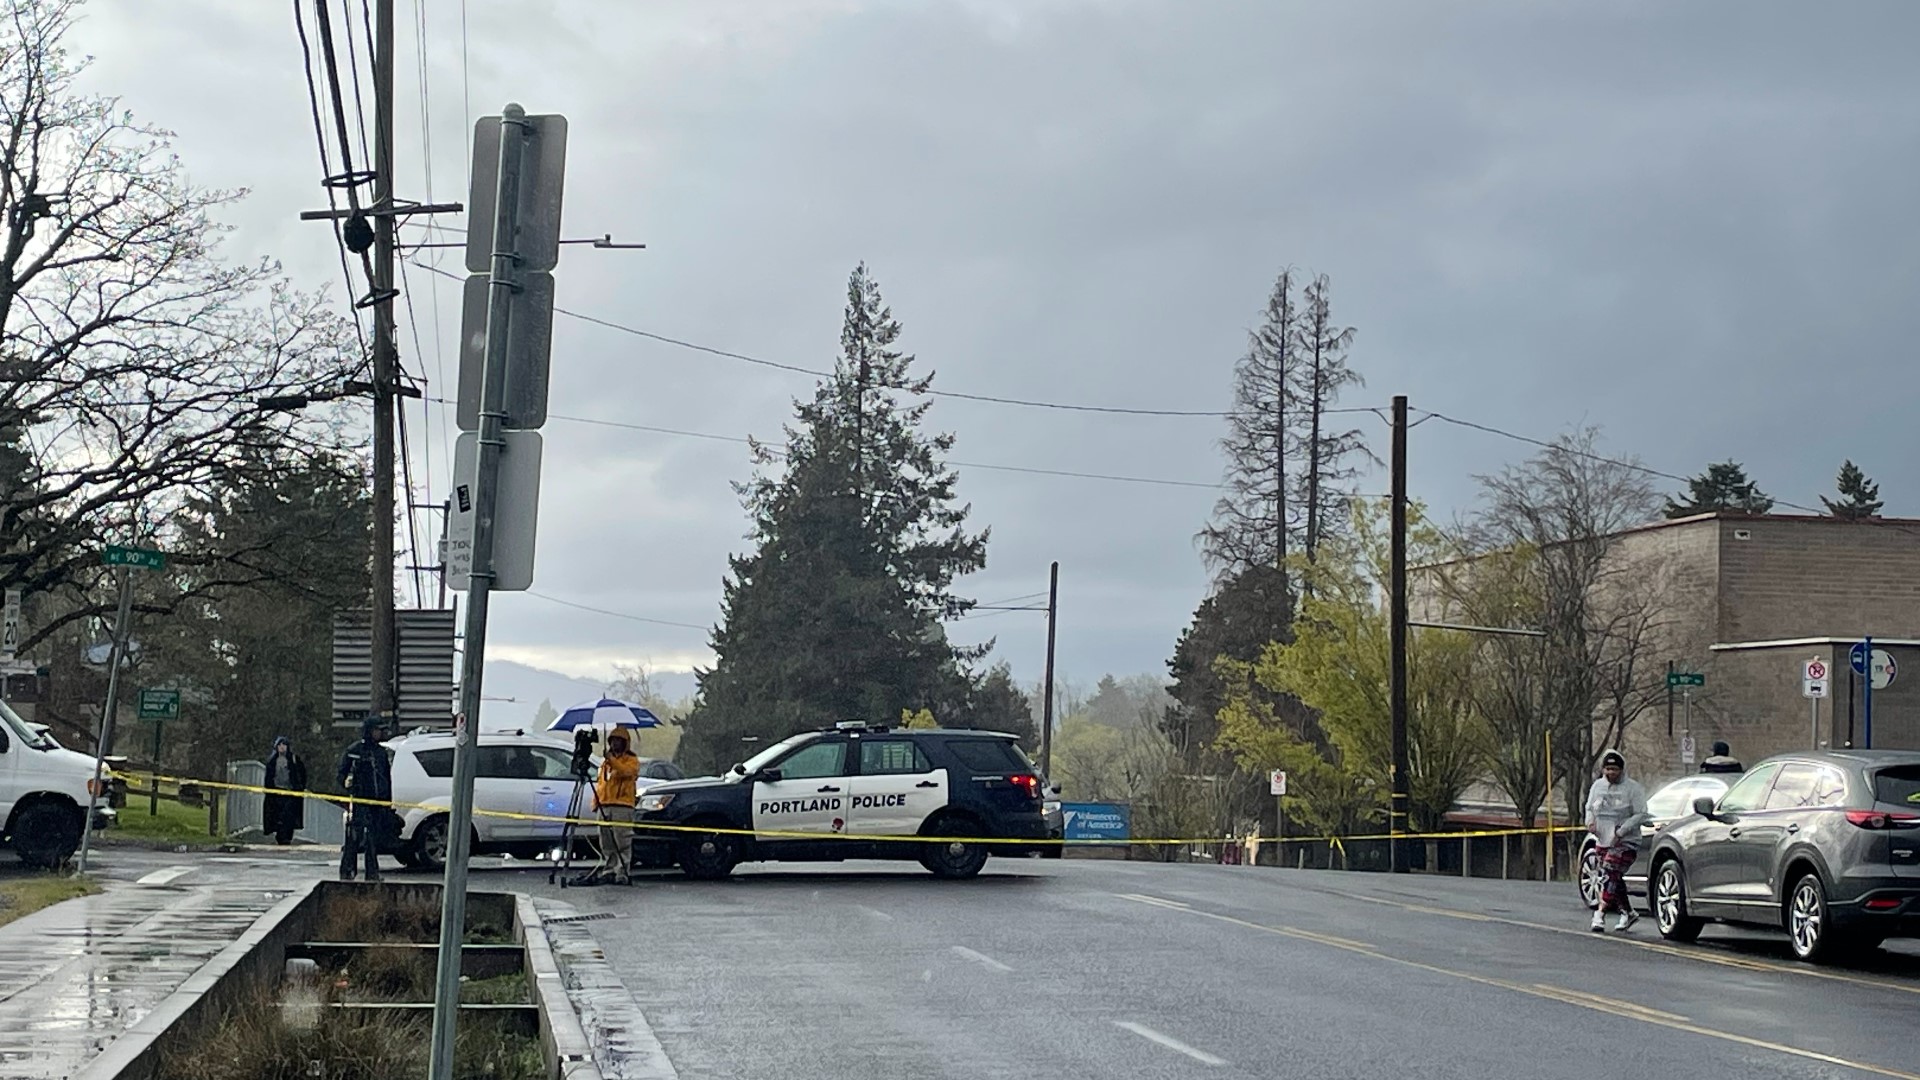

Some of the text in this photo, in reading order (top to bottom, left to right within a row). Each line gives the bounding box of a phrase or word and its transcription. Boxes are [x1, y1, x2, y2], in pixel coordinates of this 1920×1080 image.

[4, 621, 18, 645] 20
[760, 794, 907, 815] PORTLAND POLICE
